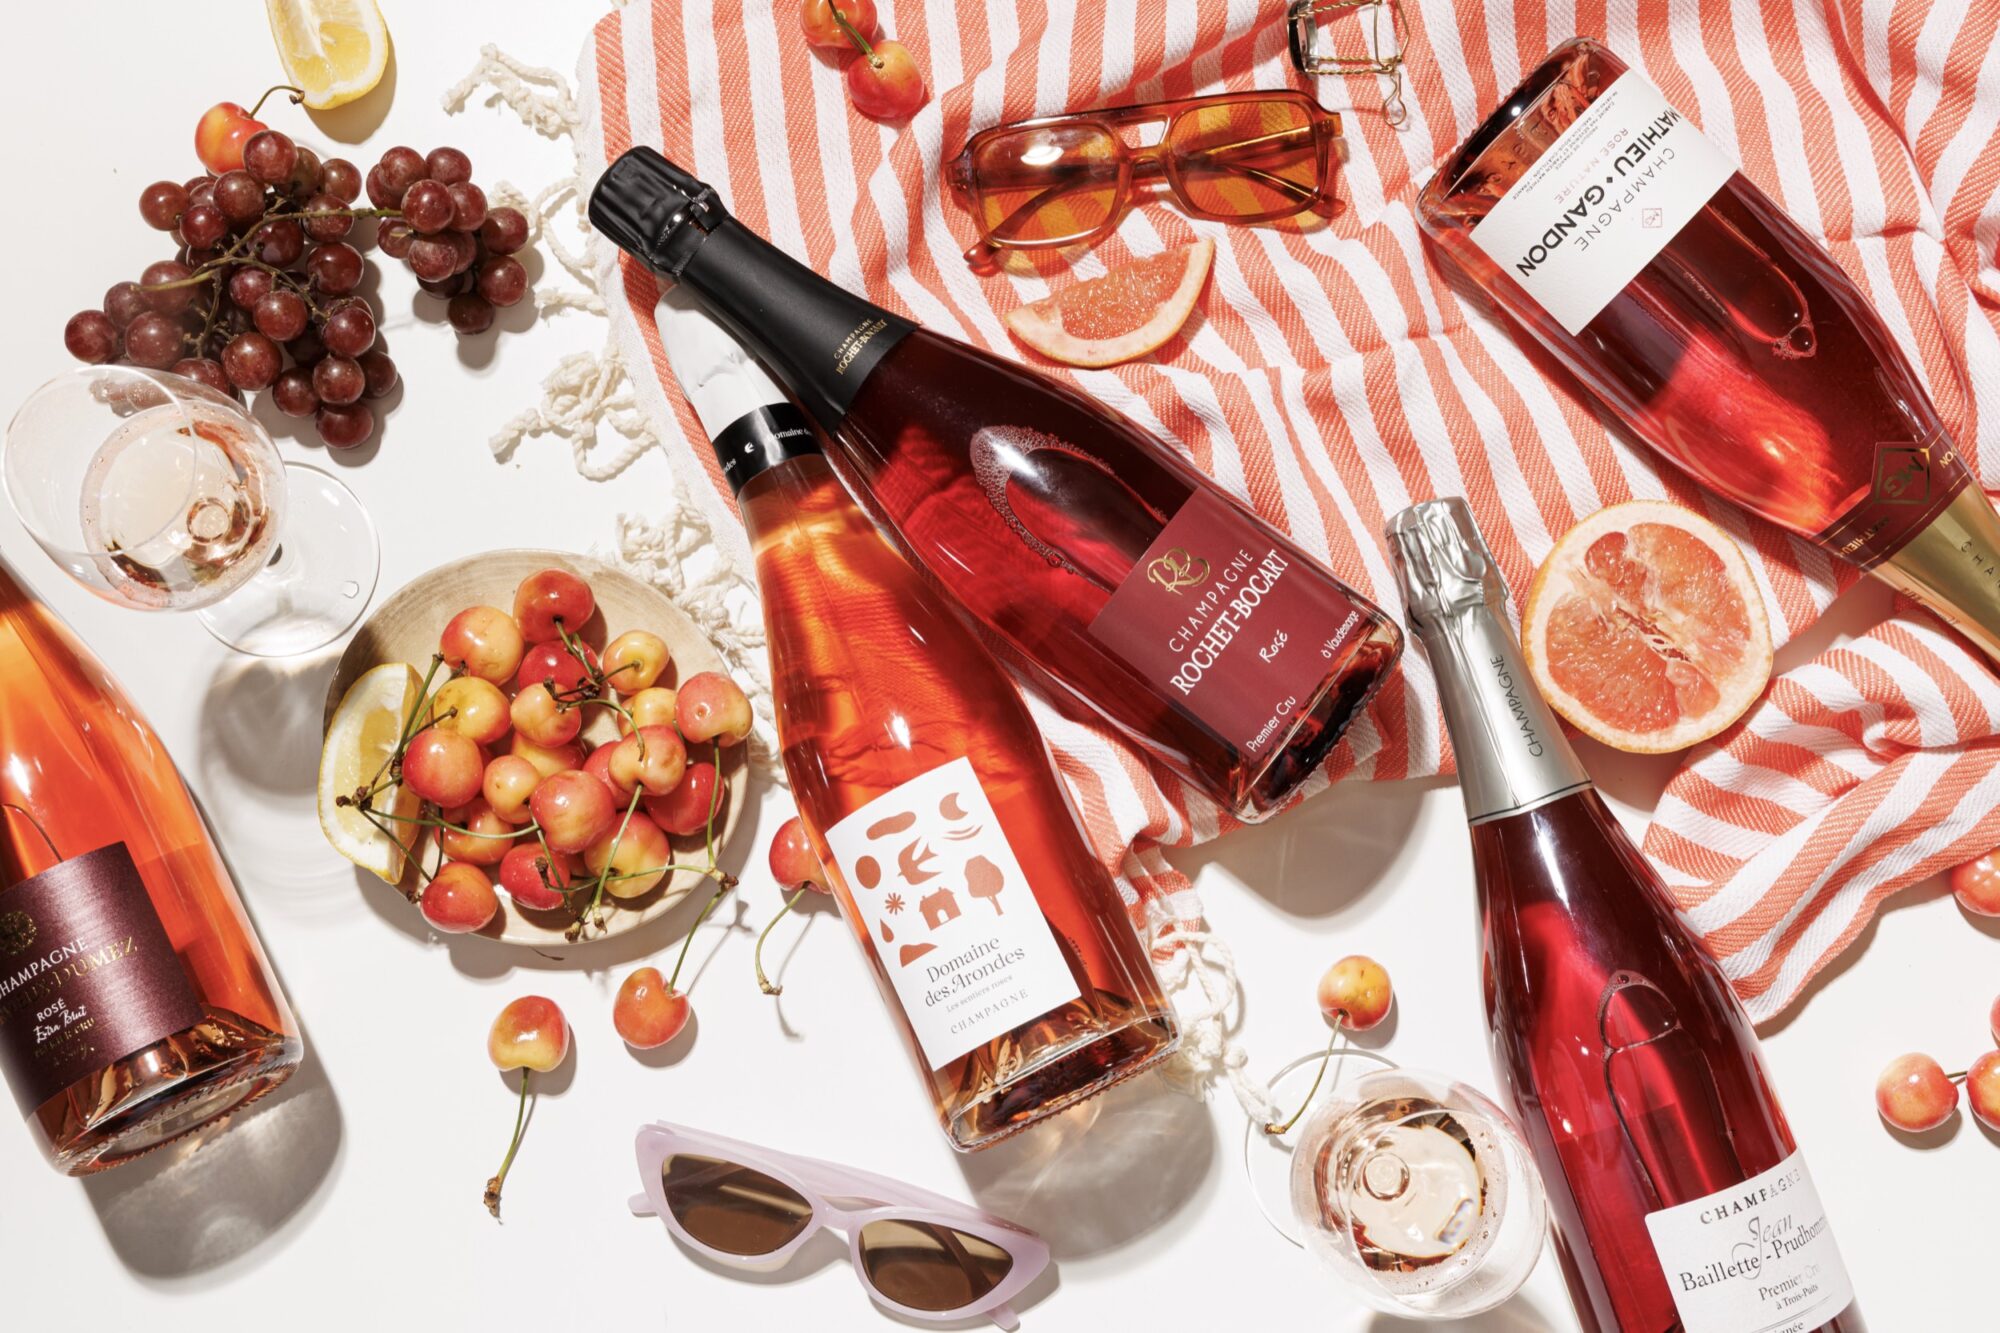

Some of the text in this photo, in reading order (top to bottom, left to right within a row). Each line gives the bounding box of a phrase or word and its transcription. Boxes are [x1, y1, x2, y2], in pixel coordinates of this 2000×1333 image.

[1602, 127, 1629, 157] ROSÉ
[1613, 107, 1681, 177] MATHIEU
[1554, 158, 1600, 205] NATURE
[1574, 147, 1675, 252] CHAMPAGNE
[1516, 185, 1605, 277] GANDON
[834, 318, 873, 360] CHAMPAGNE
[1169, 549, 1254, 653] CHAMPAGNE
[1170, 548, 1289, 696] ROCHET-BOCART
[1258, 629, 1289, 663] Rosé
[1324, 610, 1360, 654] Vaudemange
[1246, 695, 1297, 753] Premier Cru
[1490, 654, 1543, 757] CHAMPAGNE
[0, 936, 89, 1000] HAMPAGNE
[925, 947, 1025, 1007] des Arondes
[926, 937, 1001, 983] Domaine
[33, 1004, 88, 1044] Extra Brut
[36, 997, 67, 1022] ROSÉ
[950, 988, 1029, 1035] CHAMPAGNE
[1699, 1168, 1801, 1225] CHAMPAGNE
[1680, 1254, 1760, 1292] Baillette
[1732, 1214, 1793, 1280] Jean
[1759, 1273, 1803, 1301] Premier
